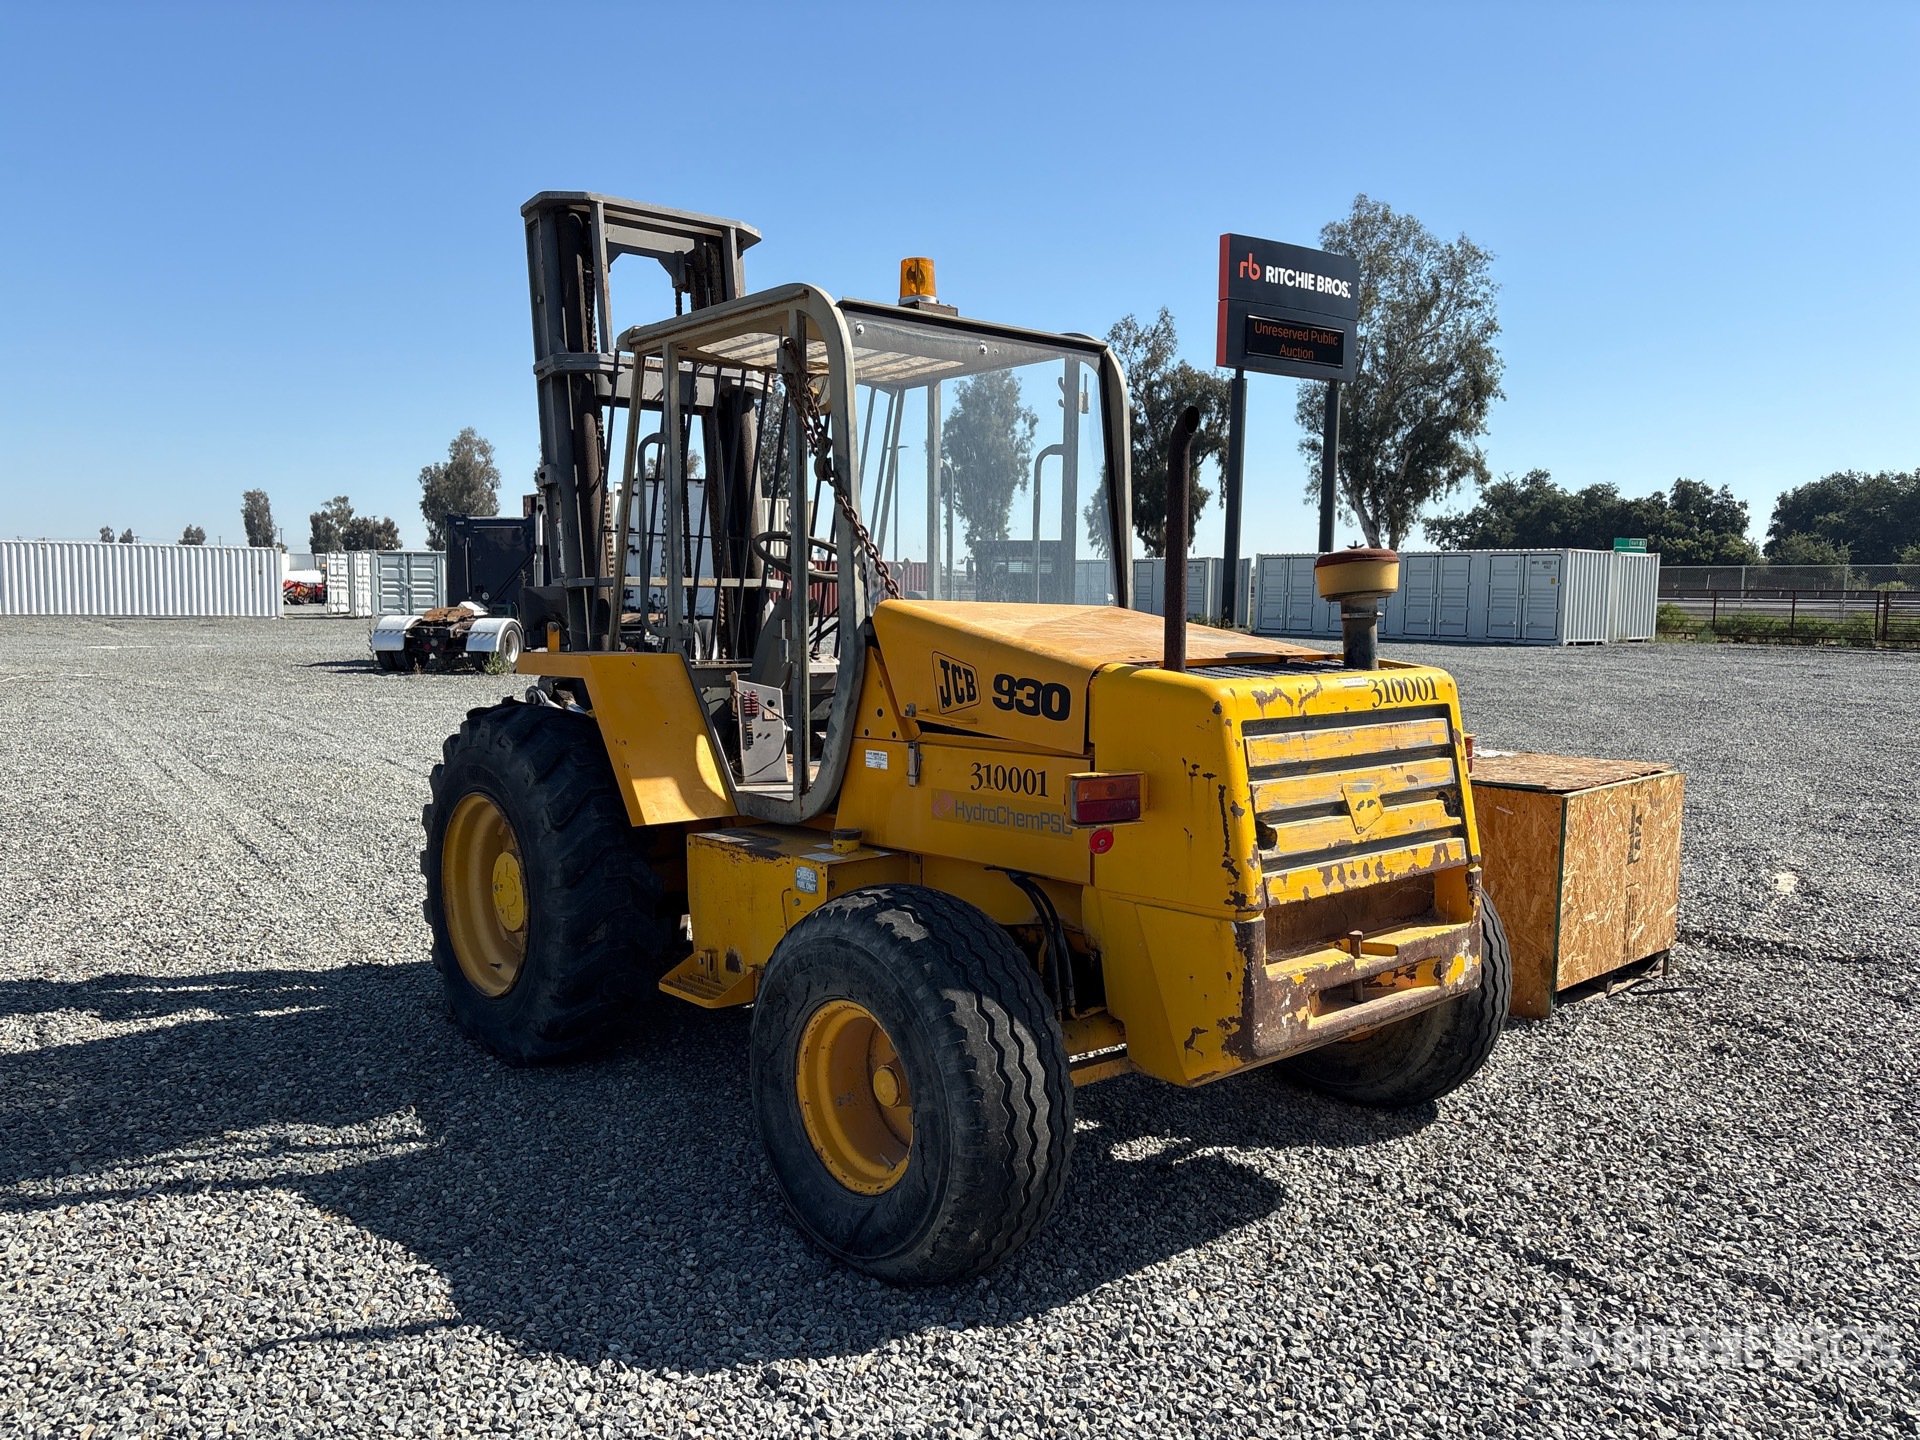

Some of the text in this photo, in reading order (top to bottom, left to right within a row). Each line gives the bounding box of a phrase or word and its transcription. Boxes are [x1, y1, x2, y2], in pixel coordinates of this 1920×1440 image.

[1239, 252, 1261, 280] rb
[1265, 265, 1315, 291] RITCHIE
[1254, 321, 1338, 346] Unreserved Public
[1279, 343, 1314, 360] Auction
[939, 659, 977, 709] JCB
[992, 673, 1071, 722] 930
[1367, 676, 1440, 708] 310001
[970, 762, 1049, 798] 310001
[797, 869, 816, 882] DIESEL
